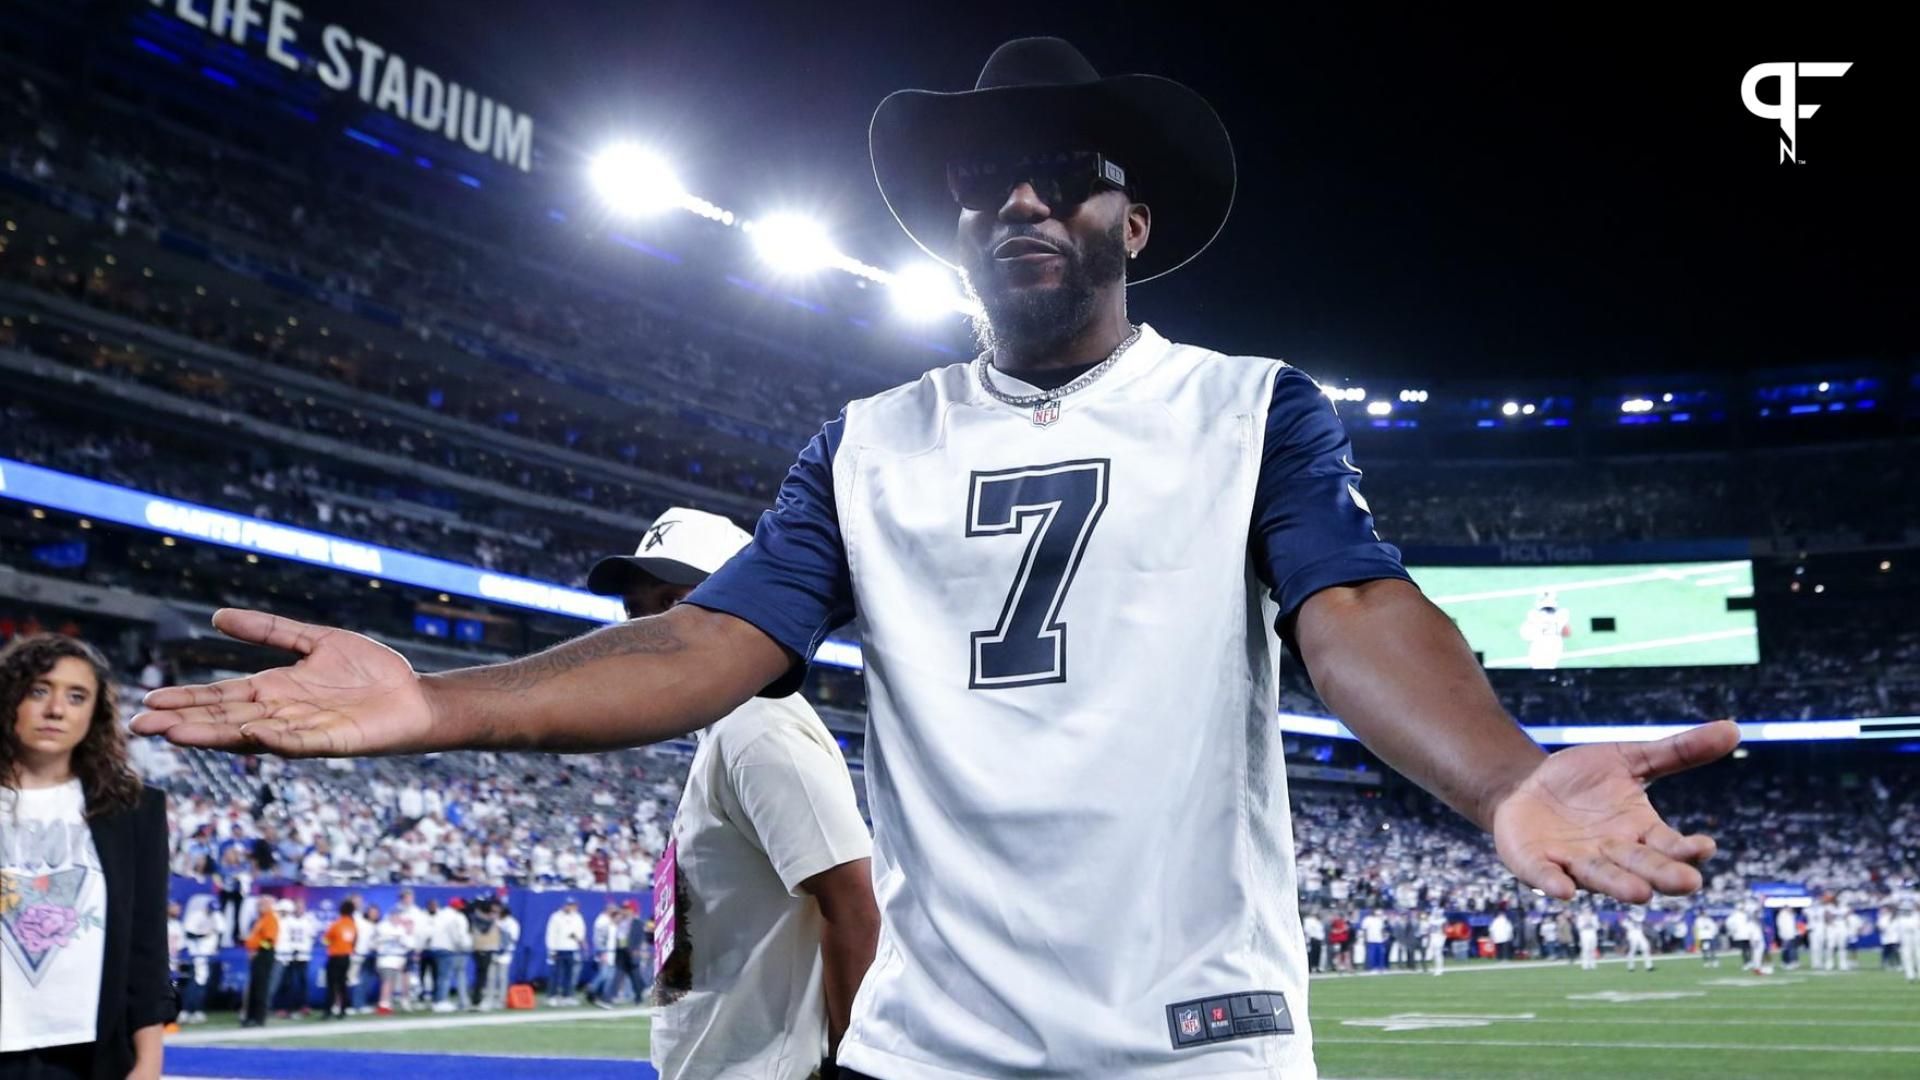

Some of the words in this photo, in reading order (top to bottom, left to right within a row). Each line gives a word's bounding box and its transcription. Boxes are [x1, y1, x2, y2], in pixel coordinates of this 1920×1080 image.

[152, 0, 303, 71] LIFE
[317, 24, 534, 173] STADIUM
[1035, 408, 1057, 422] NFL
[965, 458, 1111, 690] 7
[1247, 997, 1258, 1014] L
